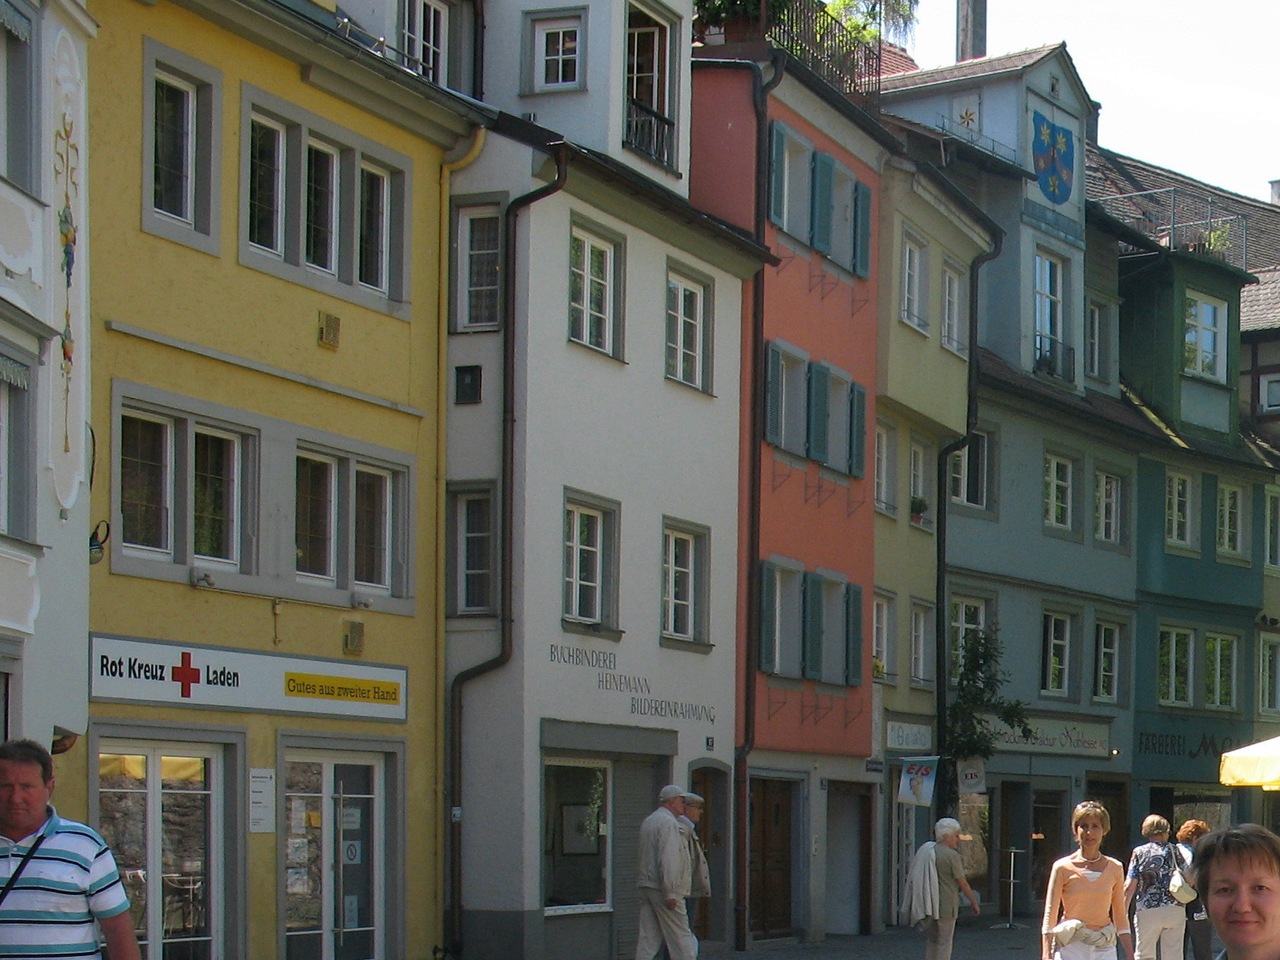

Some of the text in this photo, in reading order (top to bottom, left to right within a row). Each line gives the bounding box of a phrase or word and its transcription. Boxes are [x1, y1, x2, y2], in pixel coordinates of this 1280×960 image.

[550, 644, 616, 670] BUCHBINDEREI
[100, 654, 239, 687] Rot Kreuz Laden
[287, 678, 398, 701] Gutes aus zweiter Hand
[598, 673, 650, 694] HEINEMANN
[631, 697, 716, 725] BILDEREINRAHMUNG
[906, 763, 933, 777] EIS
[964, 772, 979, 781] EIS
